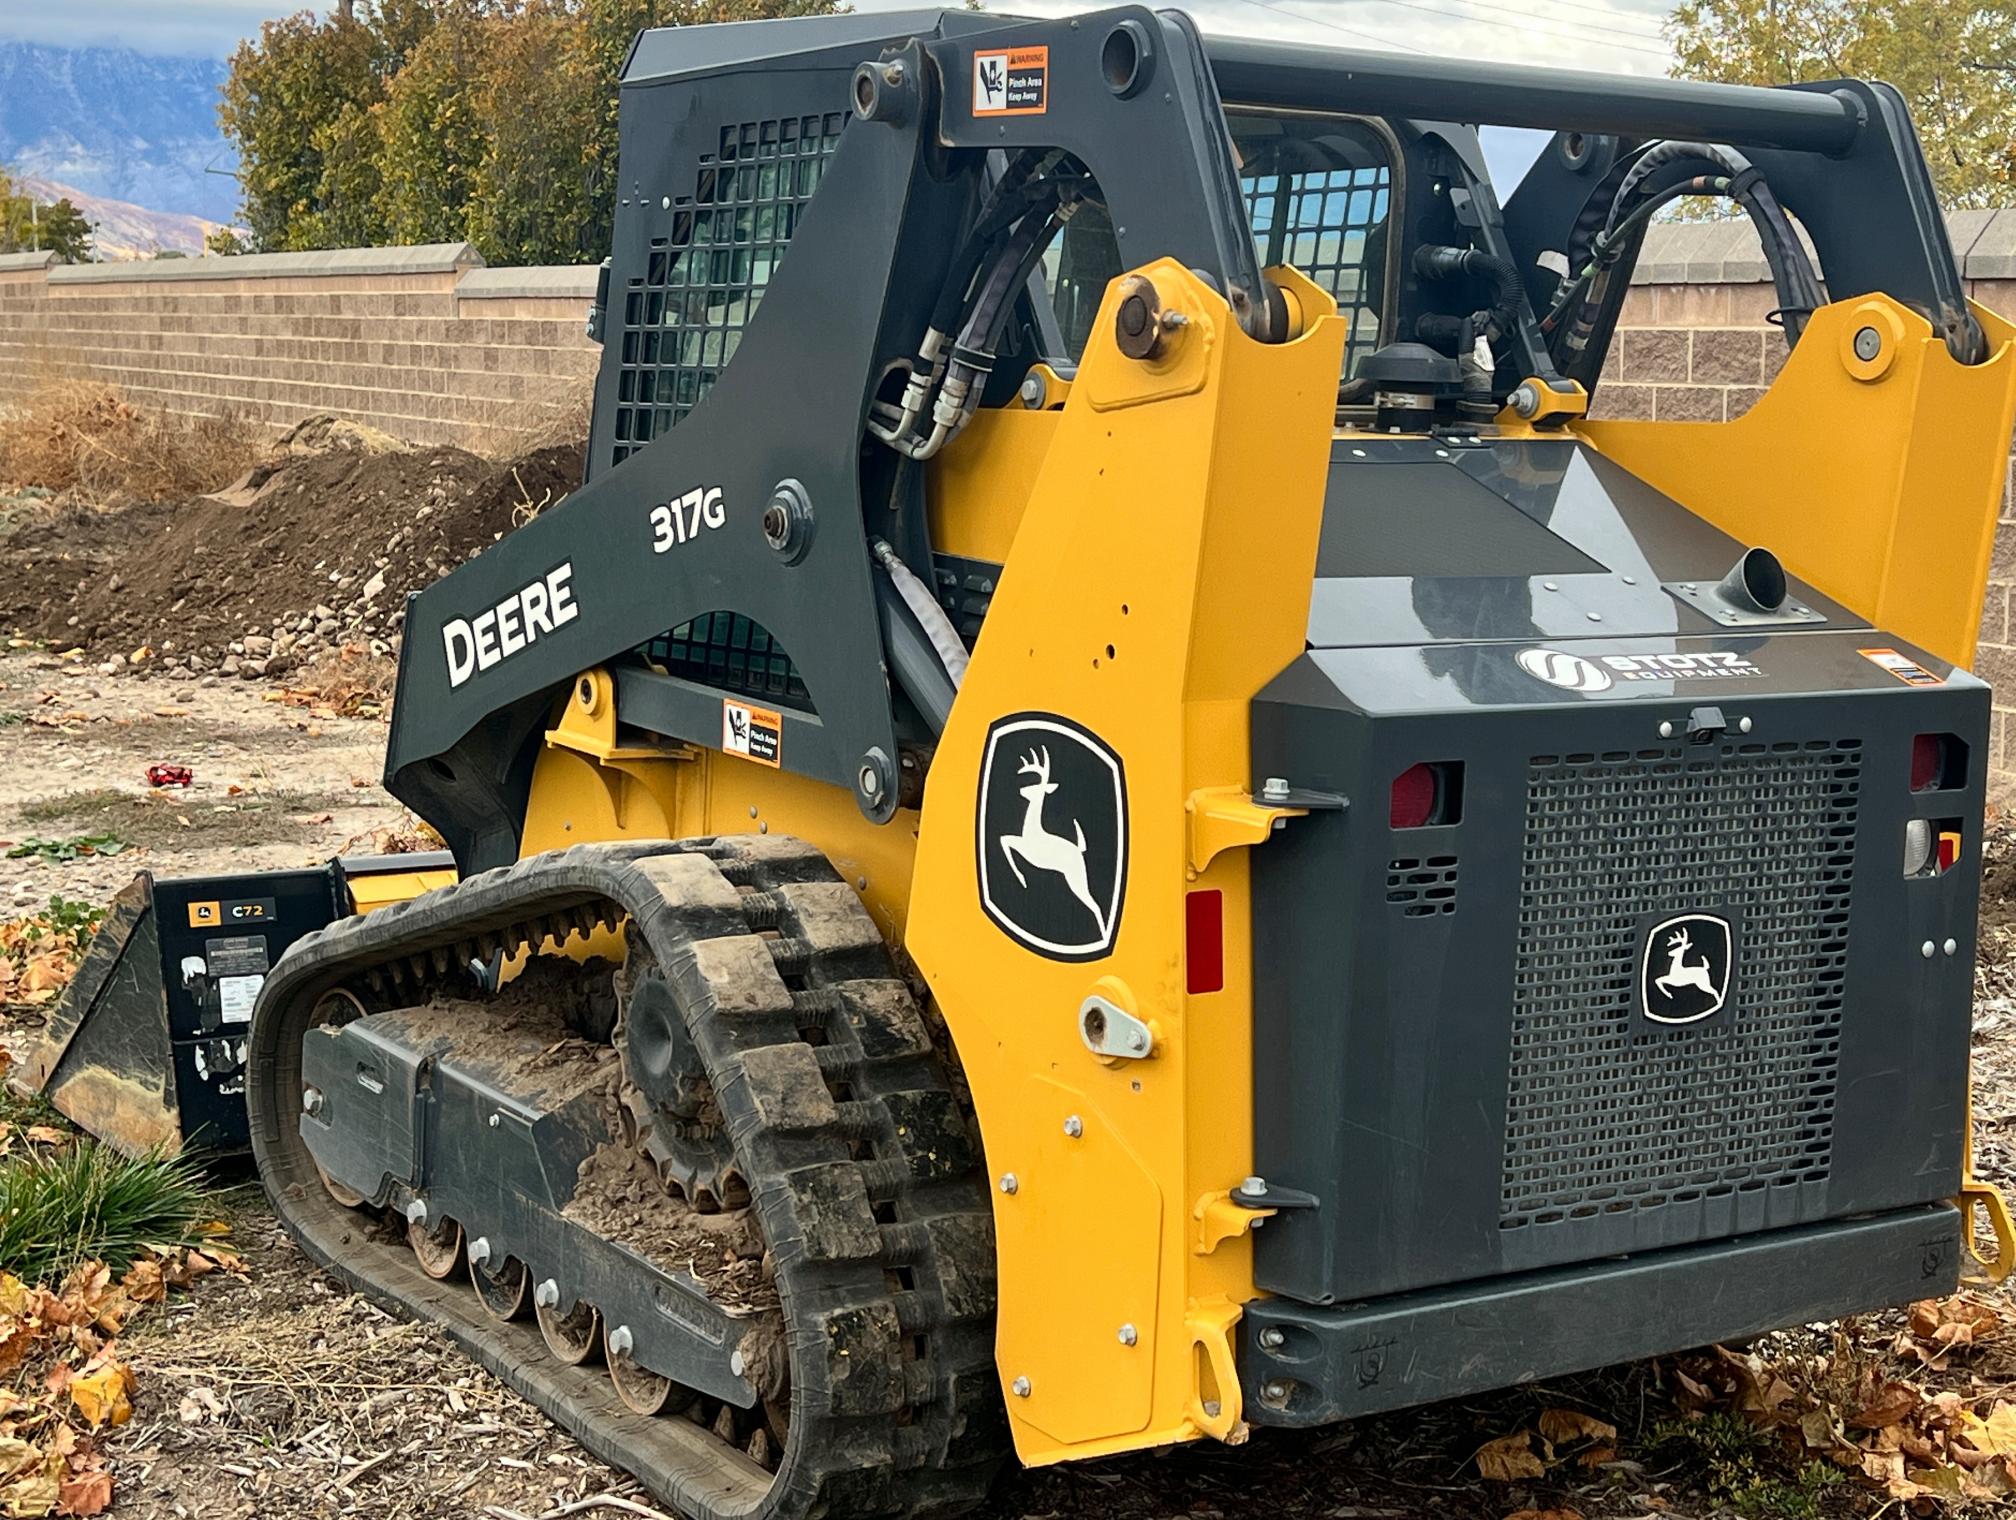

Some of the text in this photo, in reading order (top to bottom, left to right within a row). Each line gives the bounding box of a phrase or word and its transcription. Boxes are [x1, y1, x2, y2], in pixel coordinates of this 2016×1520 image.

[1008, 76, 1042, 88] Pinch Area
[1008, 92, 1037, 102] Keep Away
[650, 487, 726, 553] 317G
[442, 562, 578, 688] DEERE
[1600, 652, 1752, 671] STOTZ
[1622, 667, 1763, 680] EQUIPMENT
[232, 905, 264, 918] C72
